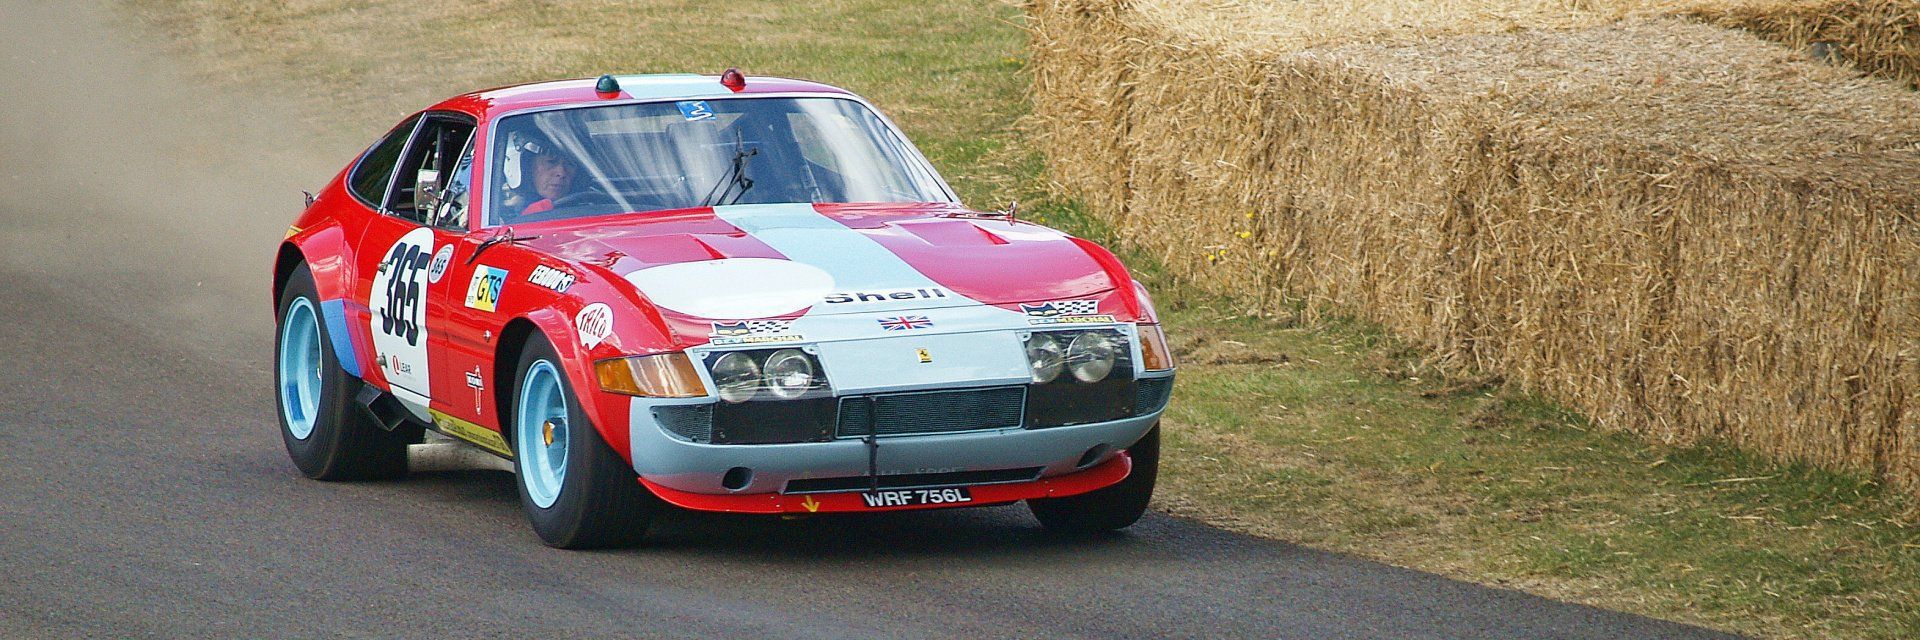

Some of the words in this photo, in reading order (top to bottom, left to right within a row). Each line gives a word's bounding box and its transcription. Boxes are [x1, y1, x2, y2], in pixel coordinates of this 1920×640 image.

[431, 258, 447, 274] 365
[381, 242, 431, 346] 365
[477, 275, 502, 303] GTS
[824, 288, 946, 304] Shell
[862, 490, 912, 507] WRF
[915, 488, 971, 504] 756L
